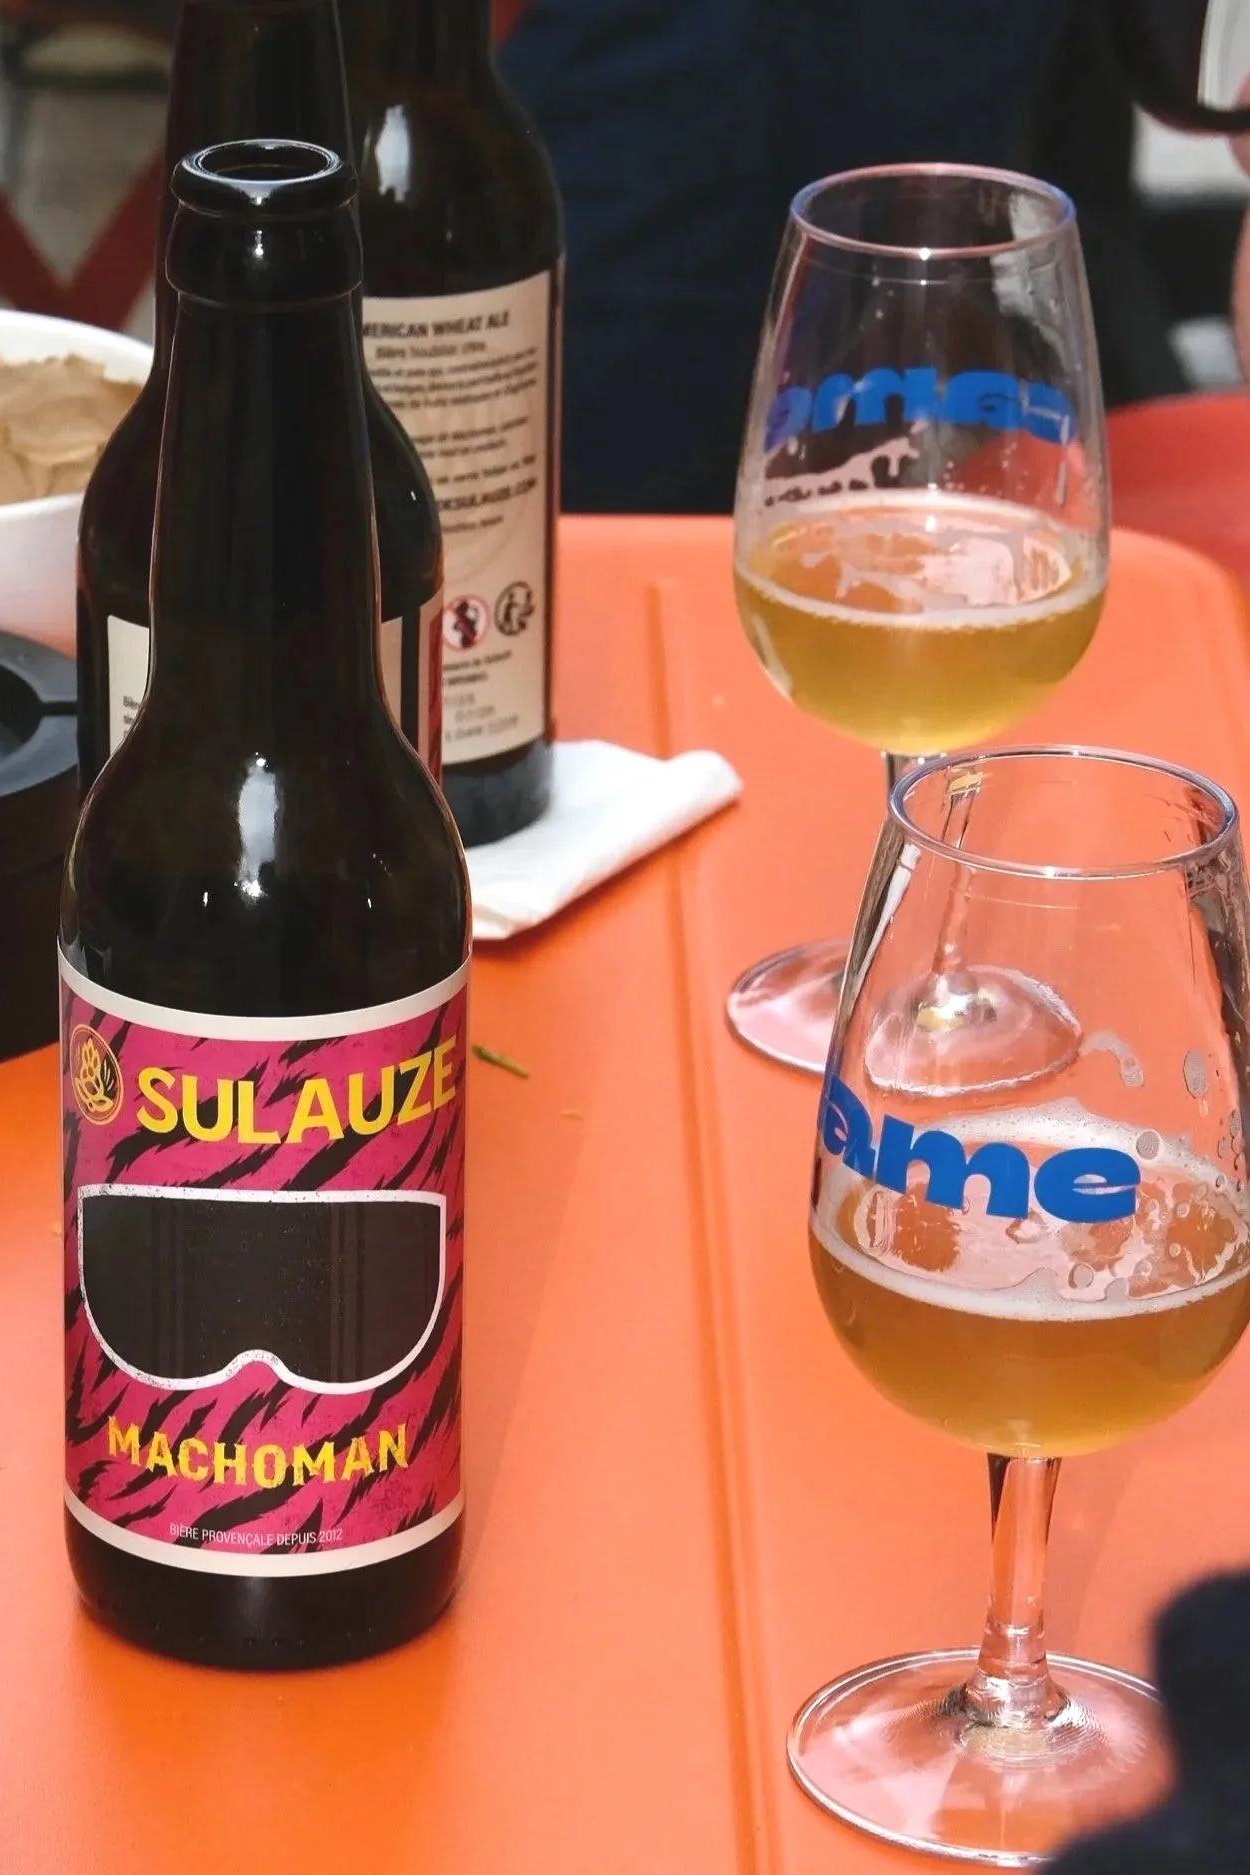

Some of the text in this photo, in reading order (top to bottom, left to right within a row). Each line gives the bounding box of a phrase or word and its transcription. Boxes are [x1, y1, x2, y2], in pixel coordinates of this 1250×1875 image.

[362, 309, 510, 337] MERICAN WHEAT ALE
[136, 1034, 457, 1144] SULAUZE
[820, 1074, 1142, 1224] ame
[107, 1415, 410, 1489] MACHOMAN
[169, 1523, 343, 1549] BIÈRE PROVENÇALE DEPUIS 2012
